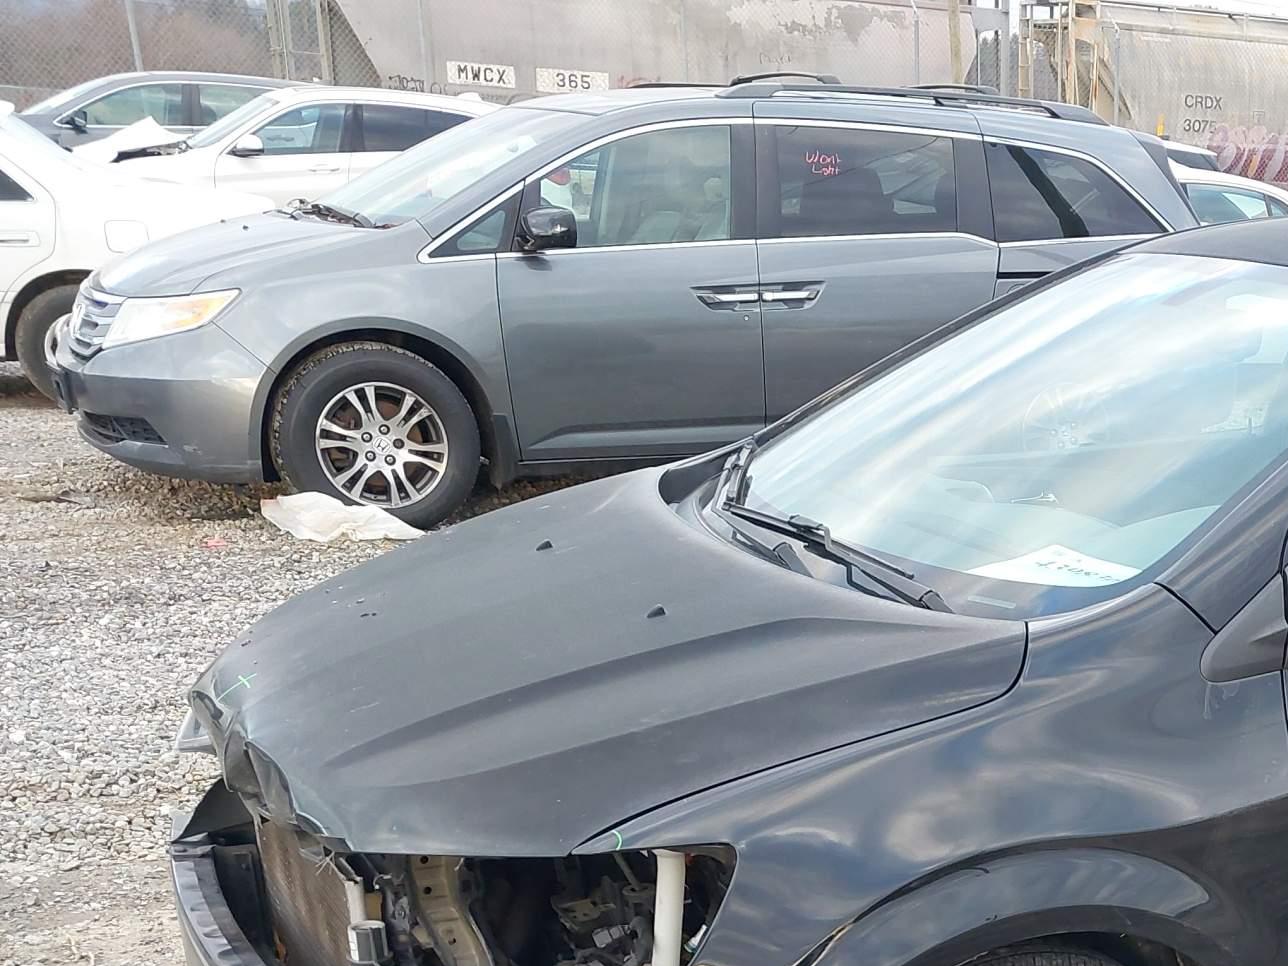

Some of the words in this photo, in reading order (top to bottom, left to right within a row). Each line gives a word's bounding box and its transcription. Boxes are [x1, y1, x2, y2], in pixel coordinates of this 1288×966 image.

[457, 64, 507, 85] MWCX
[555, 72, 591, 90] 365
[1184, 94, 1223, 111] CRDX
